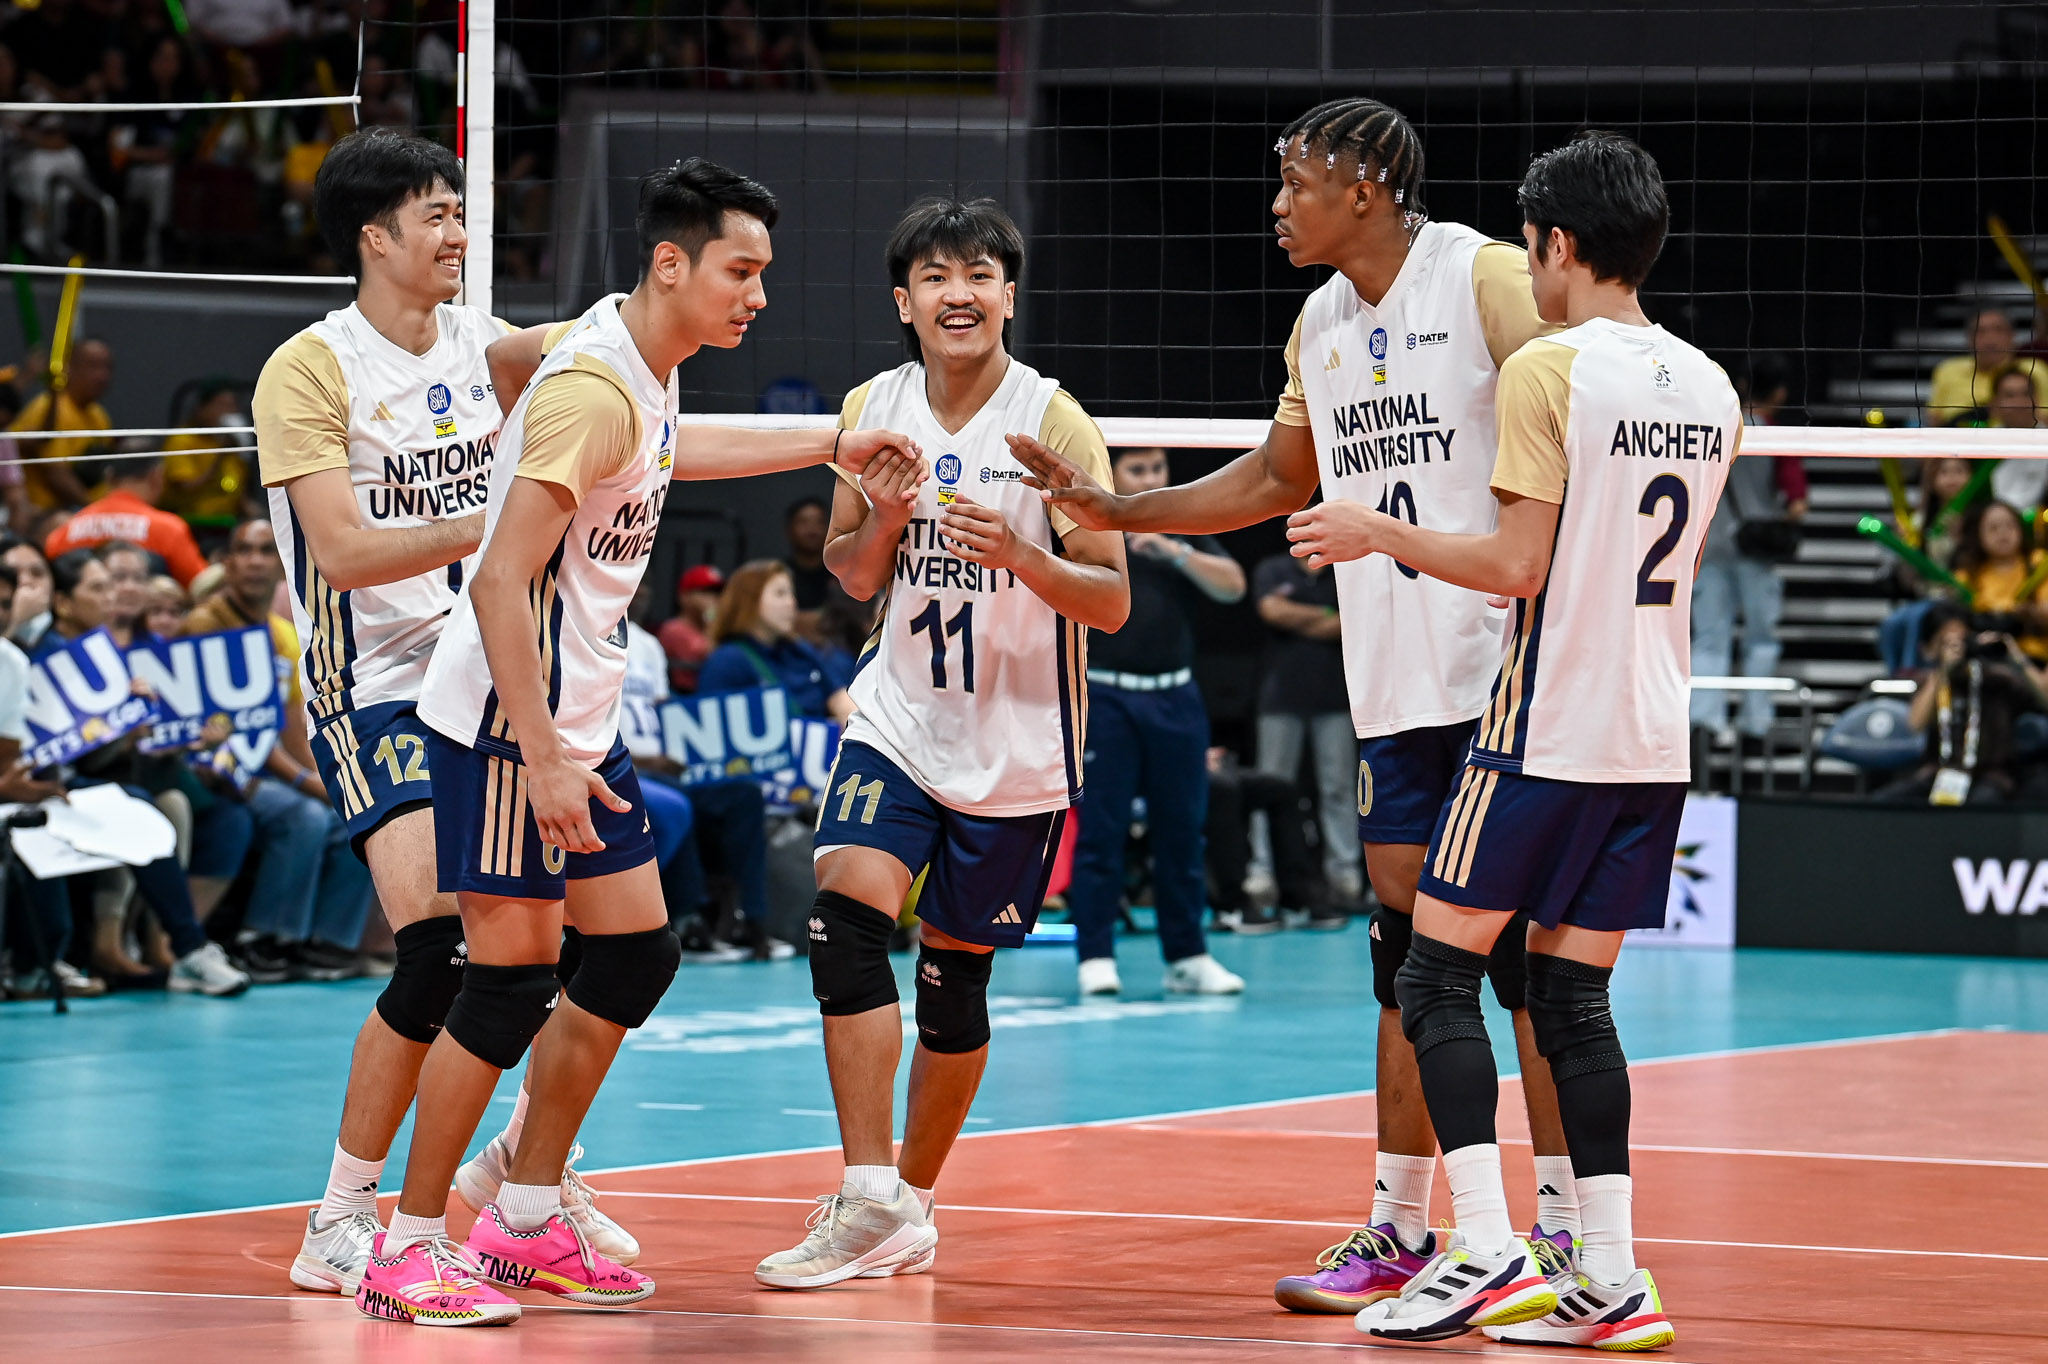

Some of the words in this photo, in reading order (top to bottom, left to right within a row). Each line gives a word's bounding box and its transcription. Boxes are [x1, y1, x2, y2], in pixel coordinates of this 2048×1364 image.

[1333, 392, 1439, 440] NATIONAL
[1610, 420, 1723, 463] ANCHETA
[382, 431, 500, 486] NATIONA
[991, 470, 1024, 480] DATEM
[1331, 428, 1457, 479] UNIVERSITY
[1635, 472, 1691, 608] 2
[909, 598, 975, 695] 11
[126, 629, 275, 717] NU
[660, 688, 788, 766] NU
[373, 734, 431, 786] 12
[835, 773, 885, 825] 11
[1357, 760, 1374, 817] 0
[450, 956, 466, 967] err
